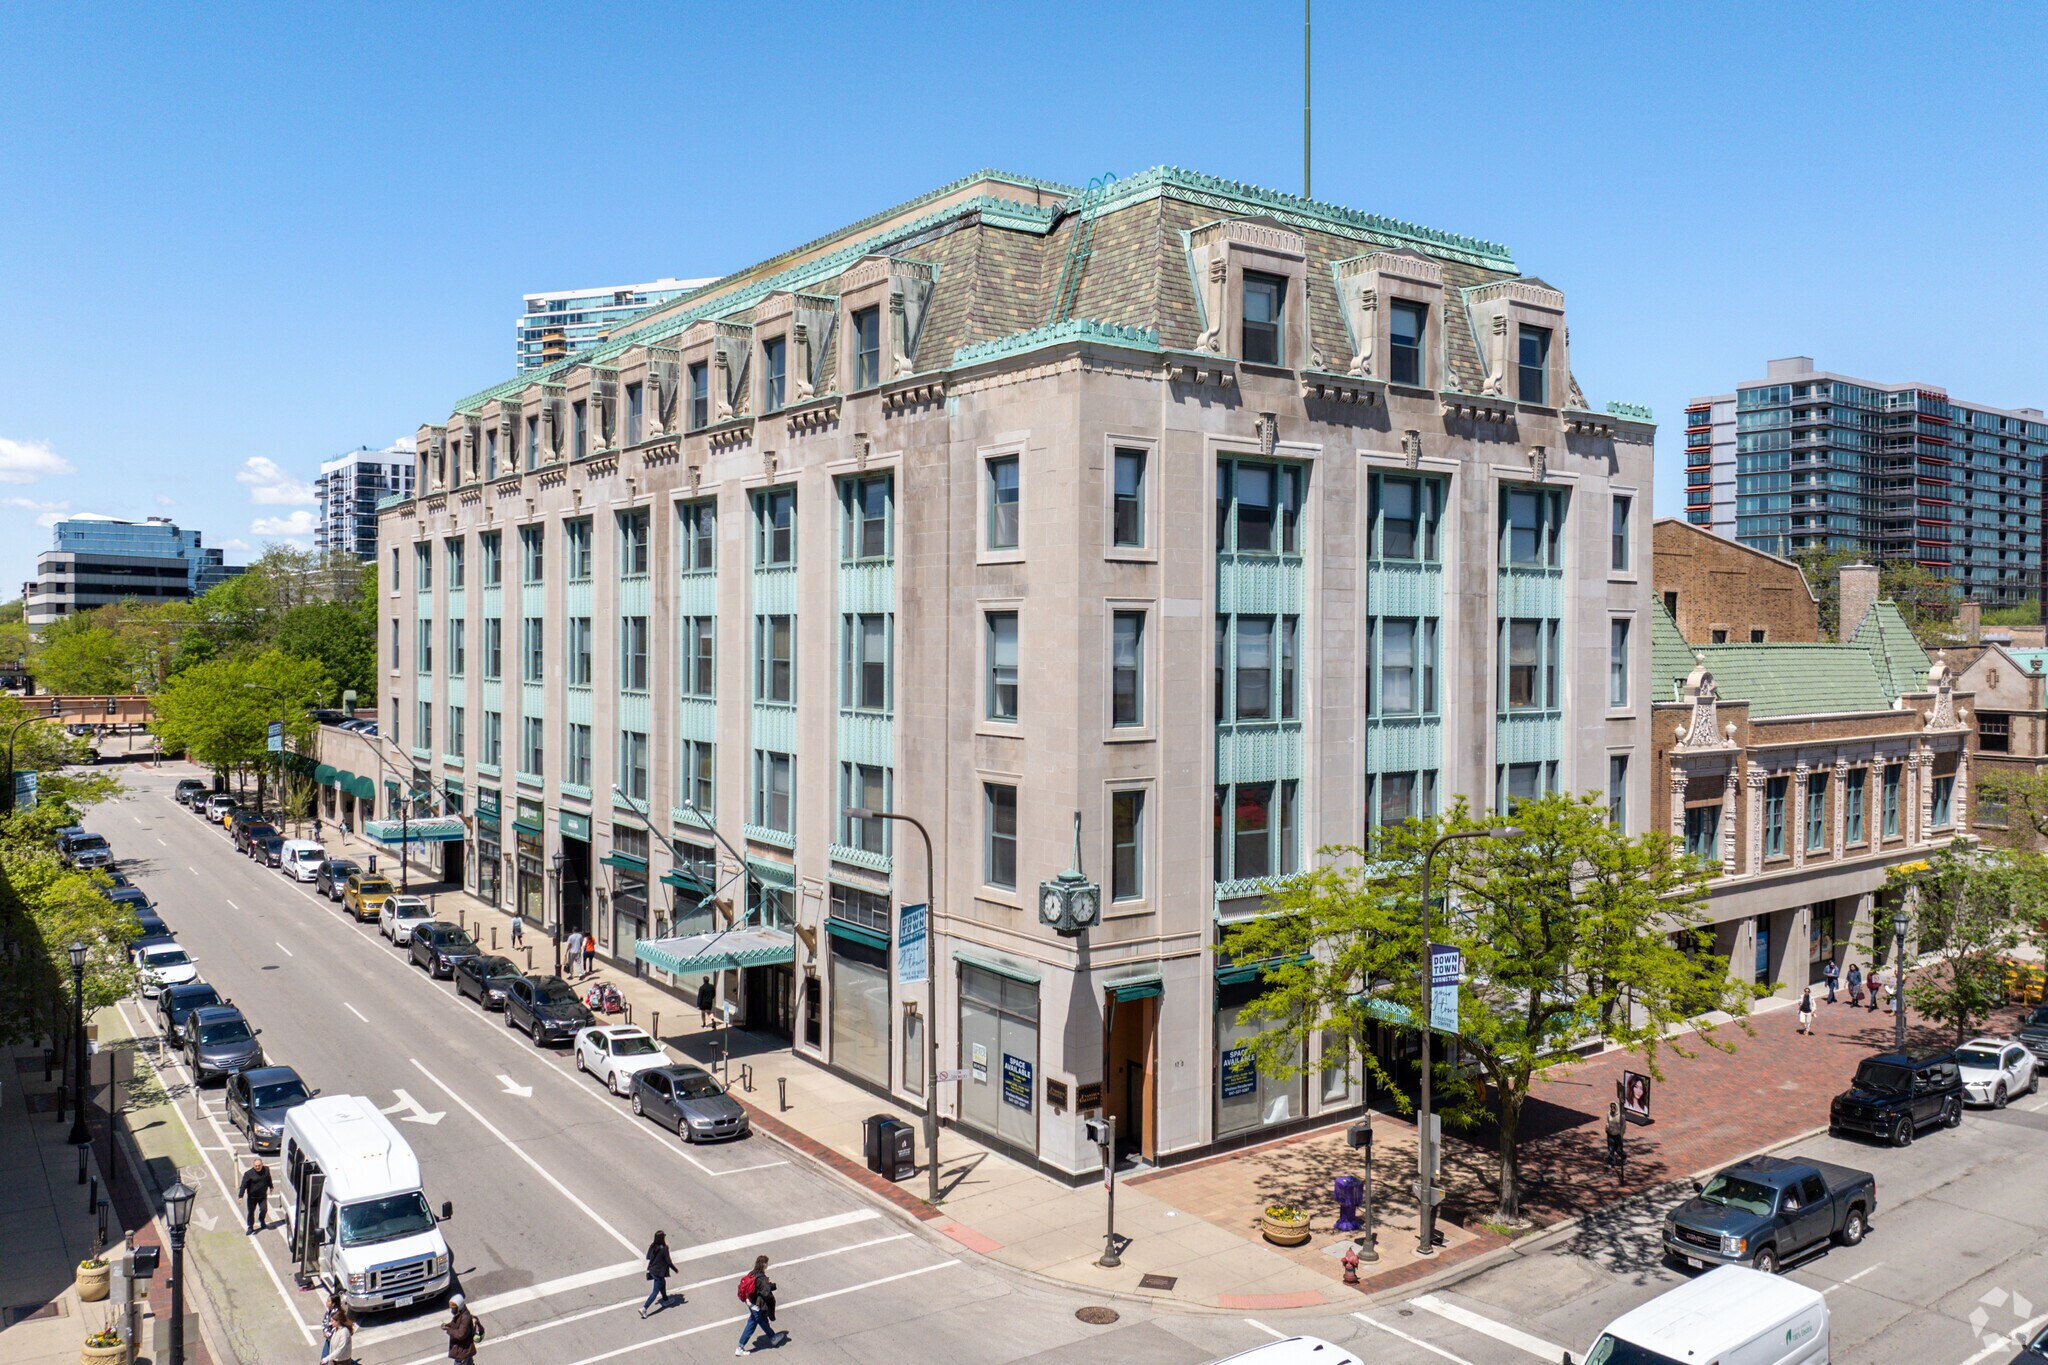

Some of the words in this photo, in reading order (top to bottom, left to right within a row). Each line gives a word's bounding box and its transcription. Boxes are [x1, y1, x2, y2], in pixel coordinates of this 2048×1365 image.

[902, 910, 924, 926] DOWN
[902, 919, 924, 935] TOWN
[1434, 954, 1457, 965] DOWN
[1434, 964, 1457, 974] TOWN
[1432, 974, 1458, 983] EVANSTON
[1230, 1048, 1250, 1058] SPAC
[1010, 1057, 1026, 1069] SPACE
[1004, 1062, 1031, 1079] AVAILABLE
